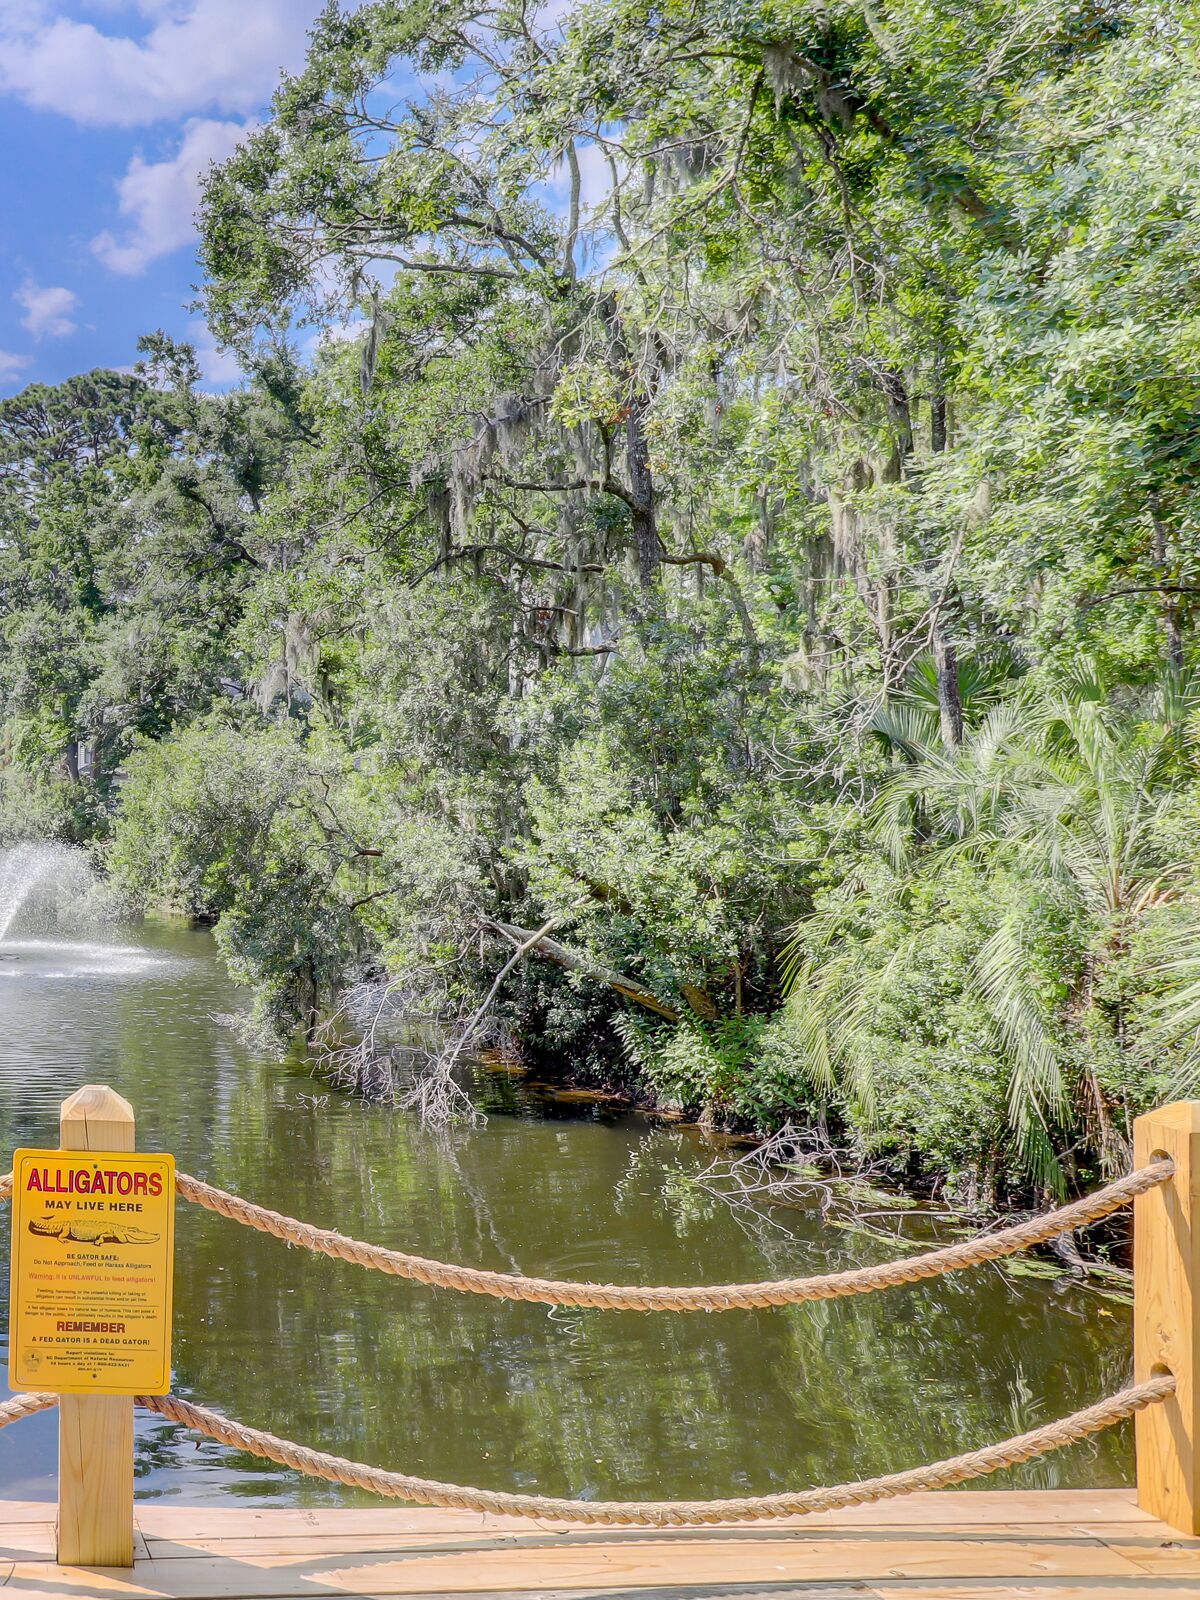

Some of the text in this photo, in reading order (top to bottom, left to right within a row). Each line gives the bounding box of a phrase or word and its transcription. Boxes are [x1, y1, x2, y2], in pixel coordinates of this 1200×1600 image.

[26, 1168, 162, 1196] ALLIGATORS
[45, 1200, 143, 1212] MAY LIVE HERE
[56, 1321, 126, 1333] REMEMBER
